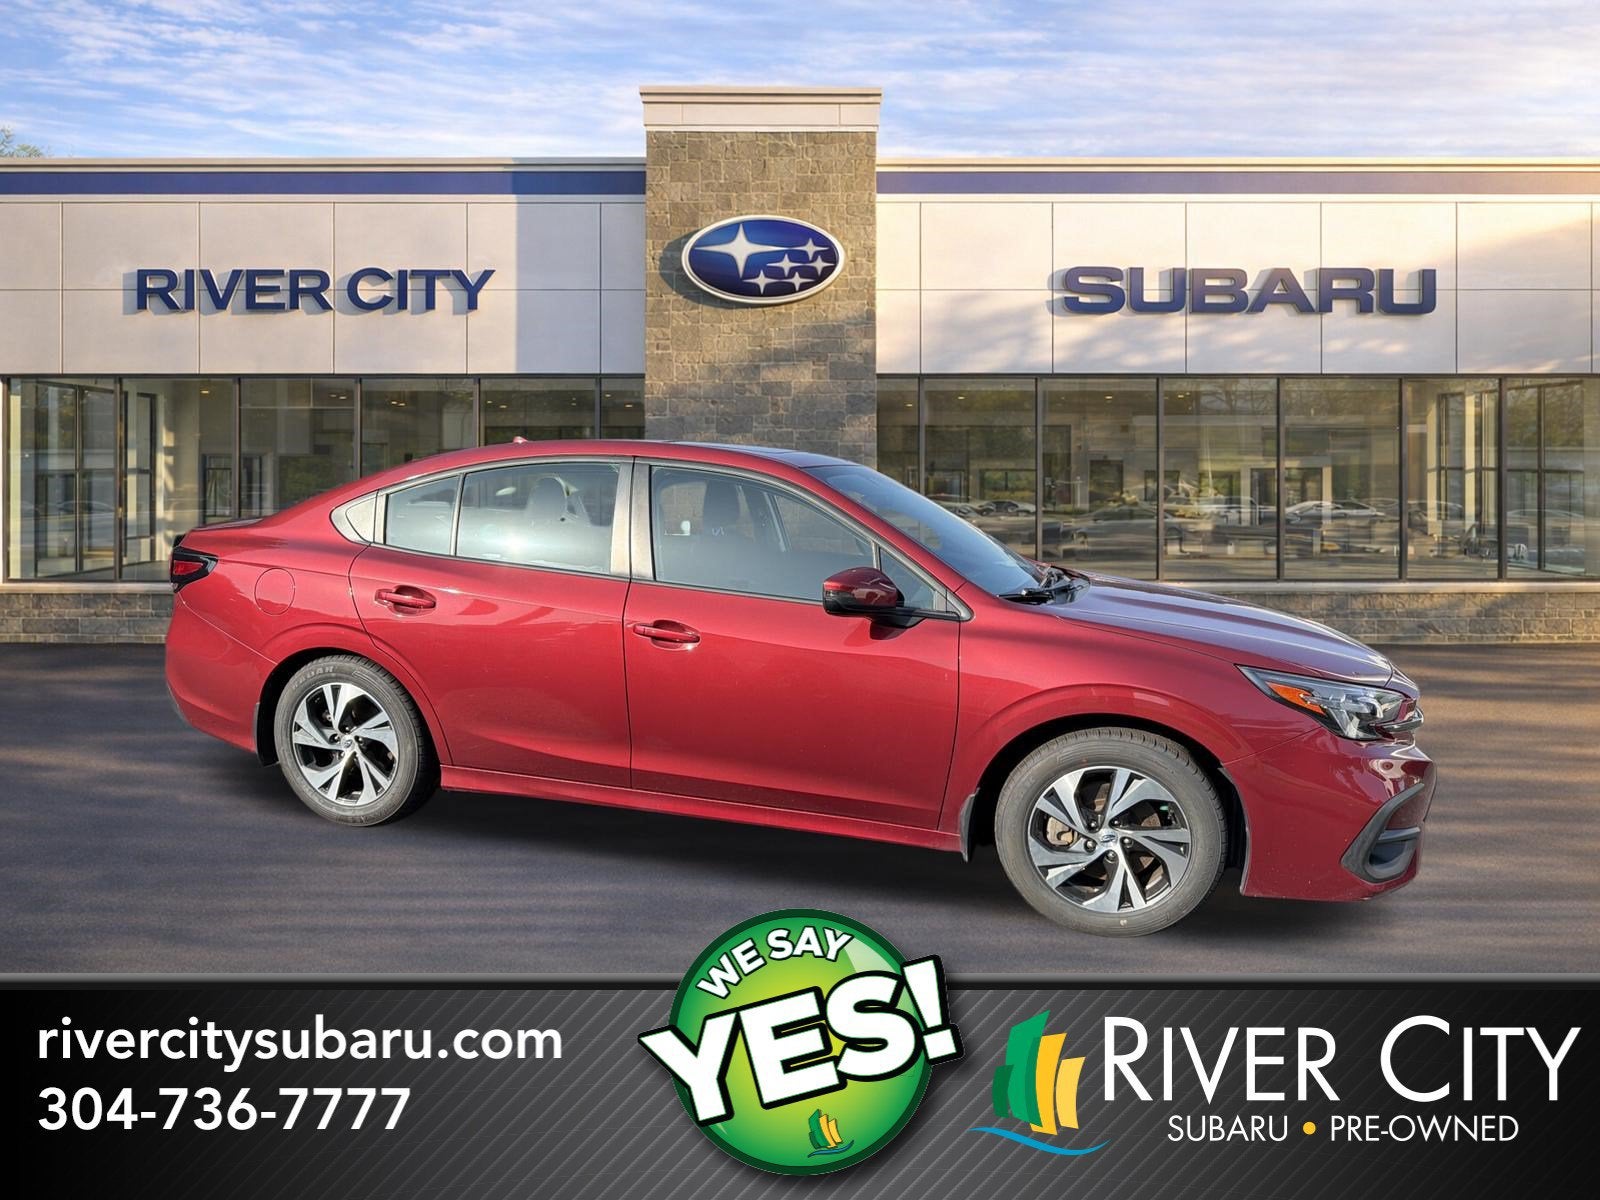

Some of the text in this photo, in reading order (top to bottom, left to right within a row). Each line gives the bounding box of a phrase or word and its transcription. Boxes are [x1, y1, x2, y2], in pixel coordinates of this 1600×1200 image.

[135, 267, 496, 312] RIVER CITY
[1063, 266, 1437, 315] SUBARU
